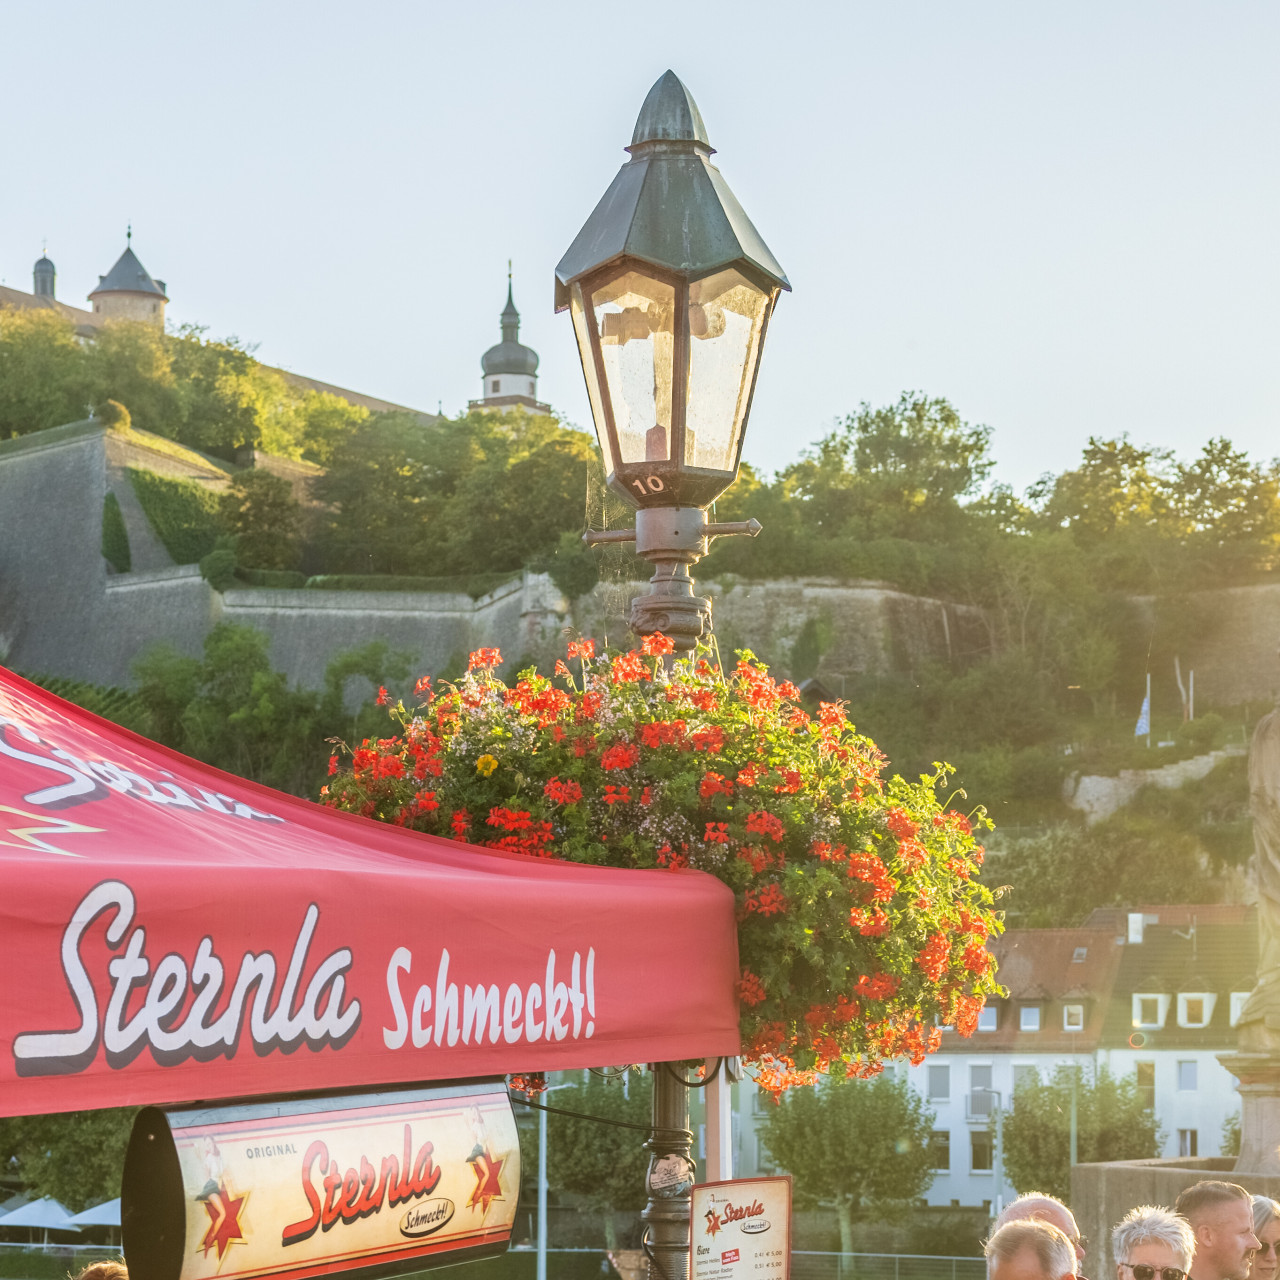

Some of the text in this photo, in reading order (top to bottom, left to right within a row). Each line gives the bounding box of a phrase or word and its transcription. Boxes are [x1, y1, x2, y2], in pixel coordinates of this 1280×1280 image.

[13, 879, 597, 1078] Sternla Schmeckt!
[246, 1143, 298, 1160] ORIGINAL
[281, 1123, 442, 1247] Sternla
[404, 1205, 448, 1232] Schmeckt!
[721, 1199, 765, 1225] Sternla
[696, 1245, 710, 1256] Biere
